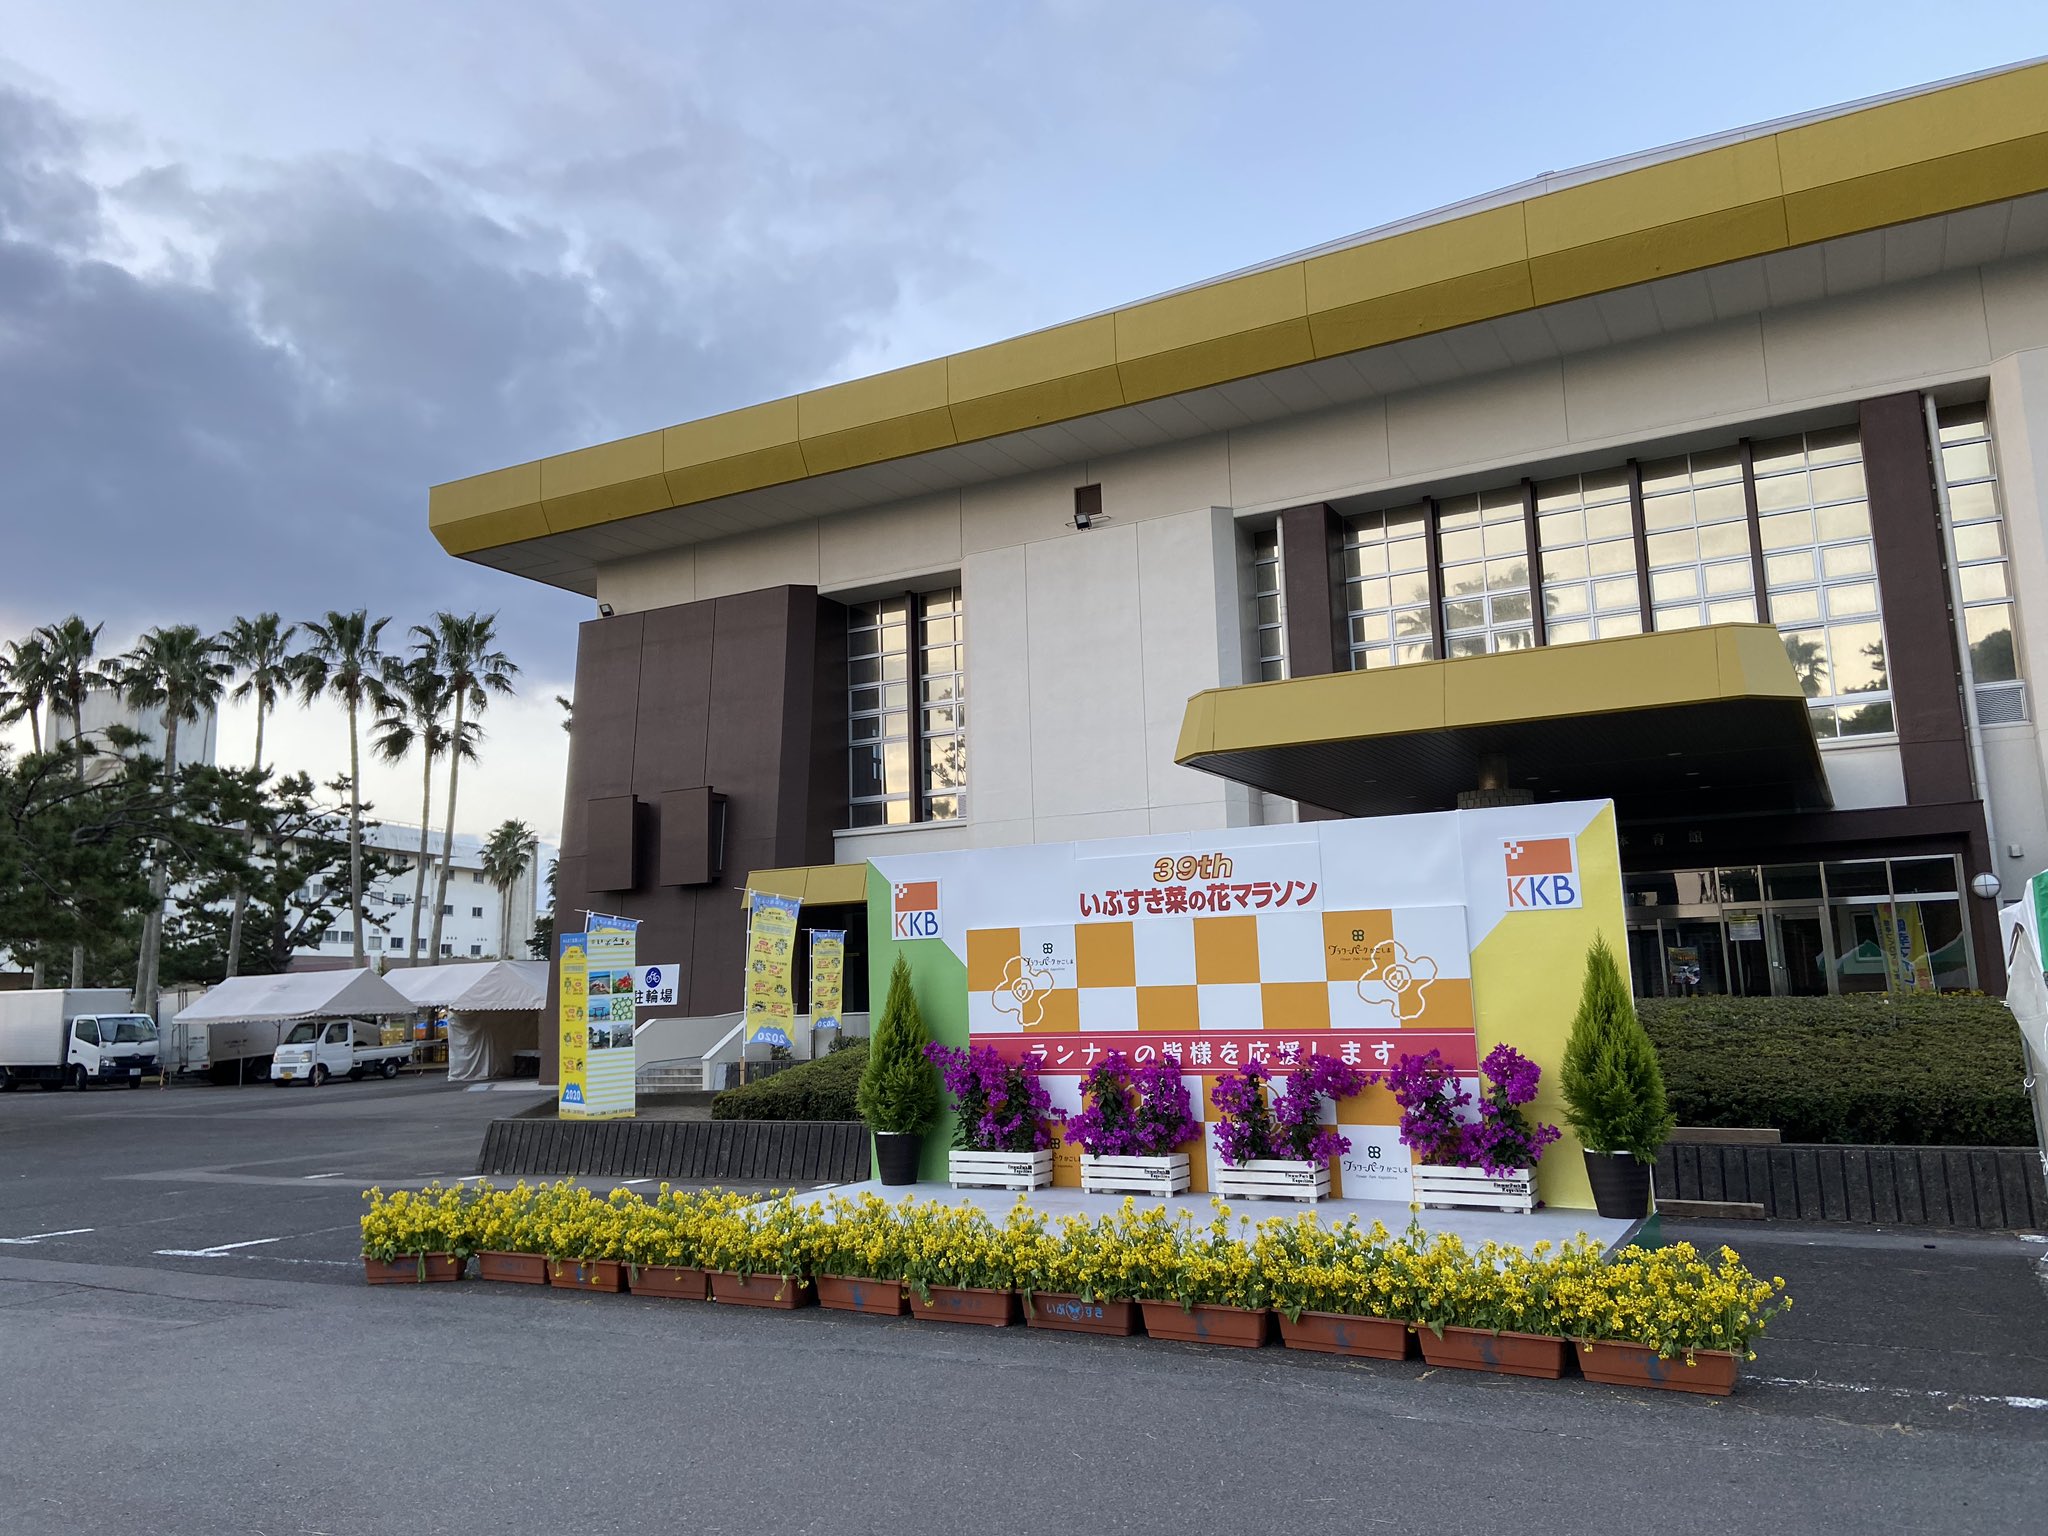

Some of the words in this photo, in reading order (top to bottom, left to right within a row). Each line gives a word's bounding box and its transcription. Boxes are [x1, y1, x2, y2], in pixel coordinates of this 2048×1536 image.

[1153, 853, 1234, 883] 39th
[1079, 880, 1317, 917] いぶすき菜の花マラソン
[1507, 875, 1575, 907] KKB
[895, 911, 938, 937] KKB
[566, 1089, 581, 1101] 2020
